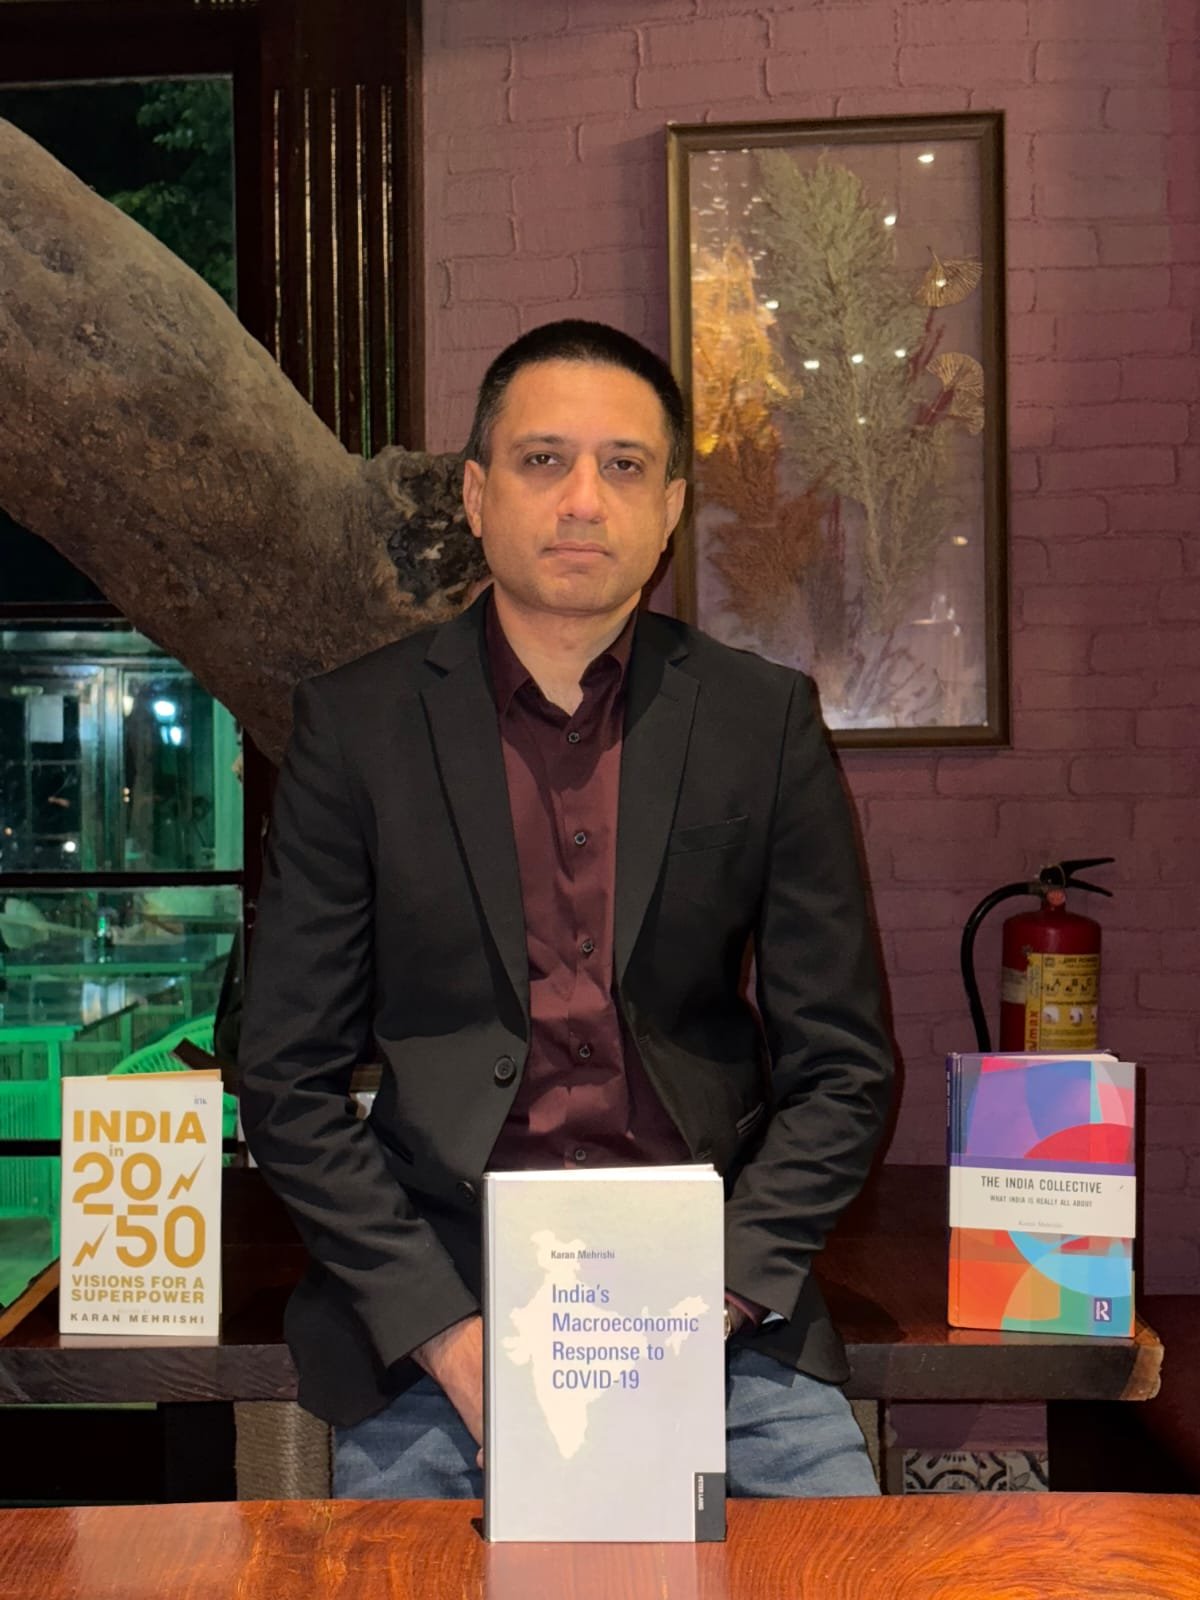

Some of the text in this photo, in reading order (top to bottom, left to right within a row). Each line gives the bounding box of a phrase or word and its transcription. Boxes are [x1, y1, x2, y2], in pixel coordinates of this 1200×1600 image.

[72, 1110, 206, 1143] INDIA
[109, 1145, 124, 1157] in
[981, 1175, 1102, 1194] THE INDIA COLLECTIVE
[1036, 1198, 1058, 1206] REALLY
[1073, 1200, 1092, 1208] ABOUT
[551, 1250, 615, 1259] Karan Mehrishi
[71, 1274, 205, 1289] VISIONS FOR A
[71, 1289, 205, 1304] SUPERPOWER
[552, 1284, 610, 1303] India's
[70, 1313, 205, 1324] KARAN MEHRISHI
[552, 1313, 699, 1332] Macroeconomic
[552, 1341, 664, 1364] Response to
[552, 1369, 640, 1389] COVID-19
